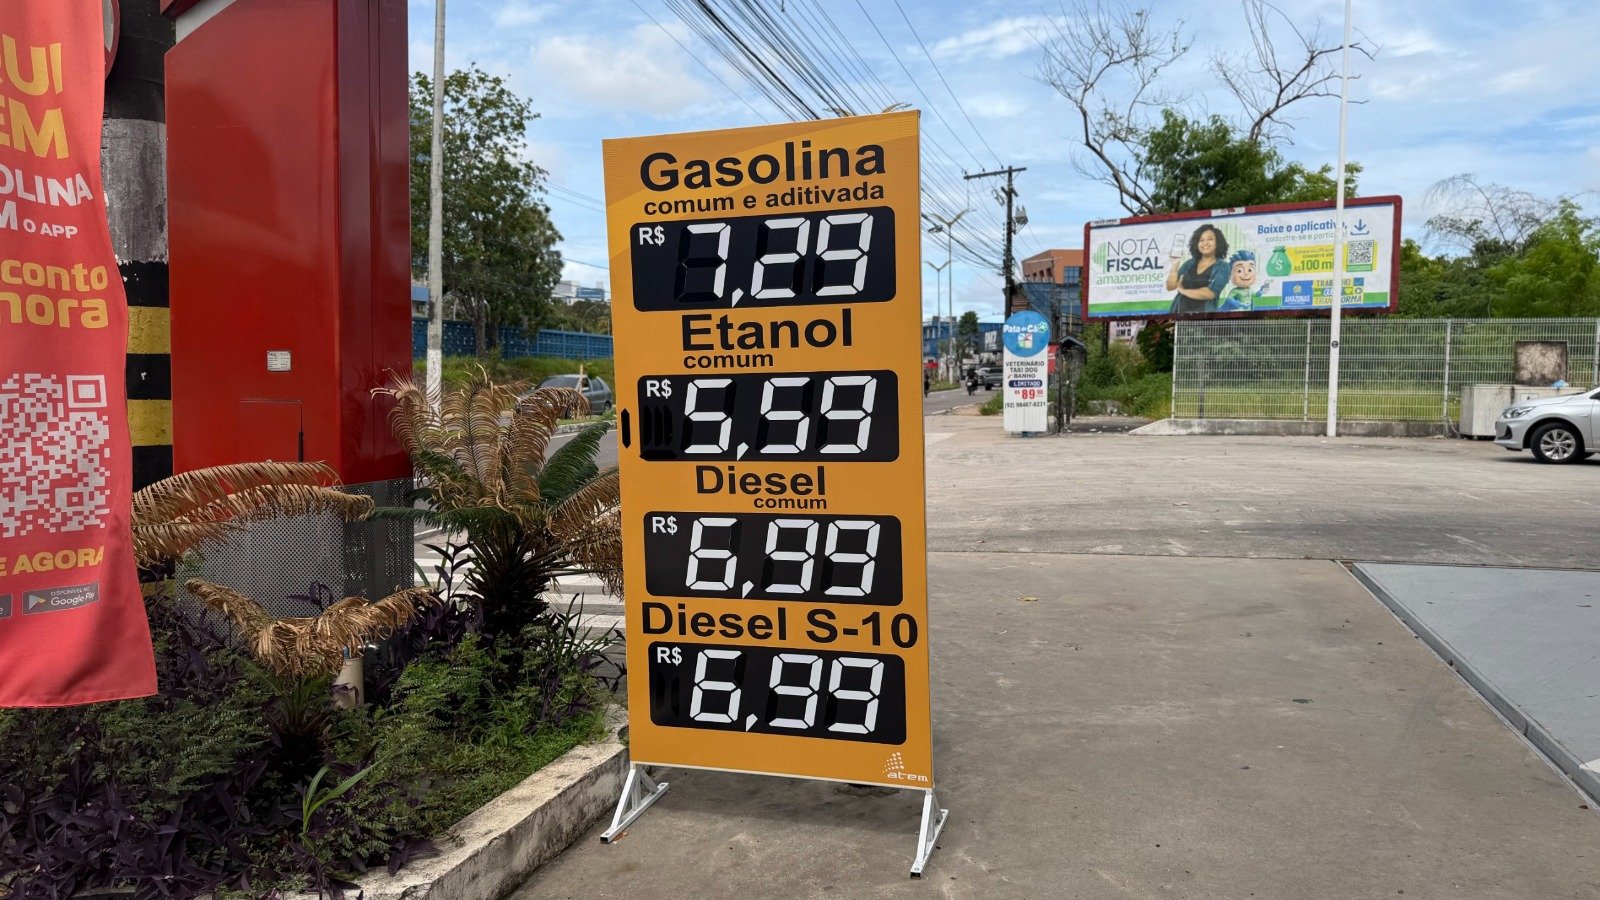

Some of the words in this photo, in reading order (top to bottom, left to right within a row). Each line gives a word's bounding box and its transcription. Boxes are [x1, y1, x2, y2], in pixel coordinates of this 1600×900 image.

[0, 34, 62, 96] UI
[640, 140, 886, 191] Gasolina
[644, 195, 734, 215] comum
[743, 195, 757, 209] e
[766, 182, 884, 207] aditivada
[23, 218, 36, 233] O
[40, 222, 78, 238] APP
[1258, 224, 1284, 235] Baixe
[1294, 219, 1347, 234] aplicativ,
[1107, 238, 1160, 257] NOTA
[638, 225, 665, 246] R$
[686, 213, 873, 308] 7,29
[1107, 257, 1164, 272] FISCAL
[1301, 259, 1320, 271] 100
[1322, 258, 1334, 269] mi
[1, 259, 108, 292] conto
[1096, 272, 1164, 286] amazonense
[1316, 279, 1351, 287] TRABHO
[1315, 296, 1362, 305] TRANORMA
[681, 308, 852, 351] Etanol
[1003, 324, 1020, 333] Pata
[683, 353, 774, 369] comum
[1022, 389, 1035, 399] 89
[646, 378, 672, 399] R$
[684, 375, 877, 461] 5,59
[695, 466, 825, 496] Diesel
[753, 497, 827, 509] comum
[12, 545, 105, 575] AGORA
[652, 515, 678, 535] R$
[685, 517, 880, 599] 6,99
[51, 594, 84, 606] Google
[642, 602, 787, 641] Diesel
[806, 608, 918, 649] S-10
[656, 646, 682, 666] R$
[690, 649, 884, 734] 6,99
[887, 771, 928, 782] atem
